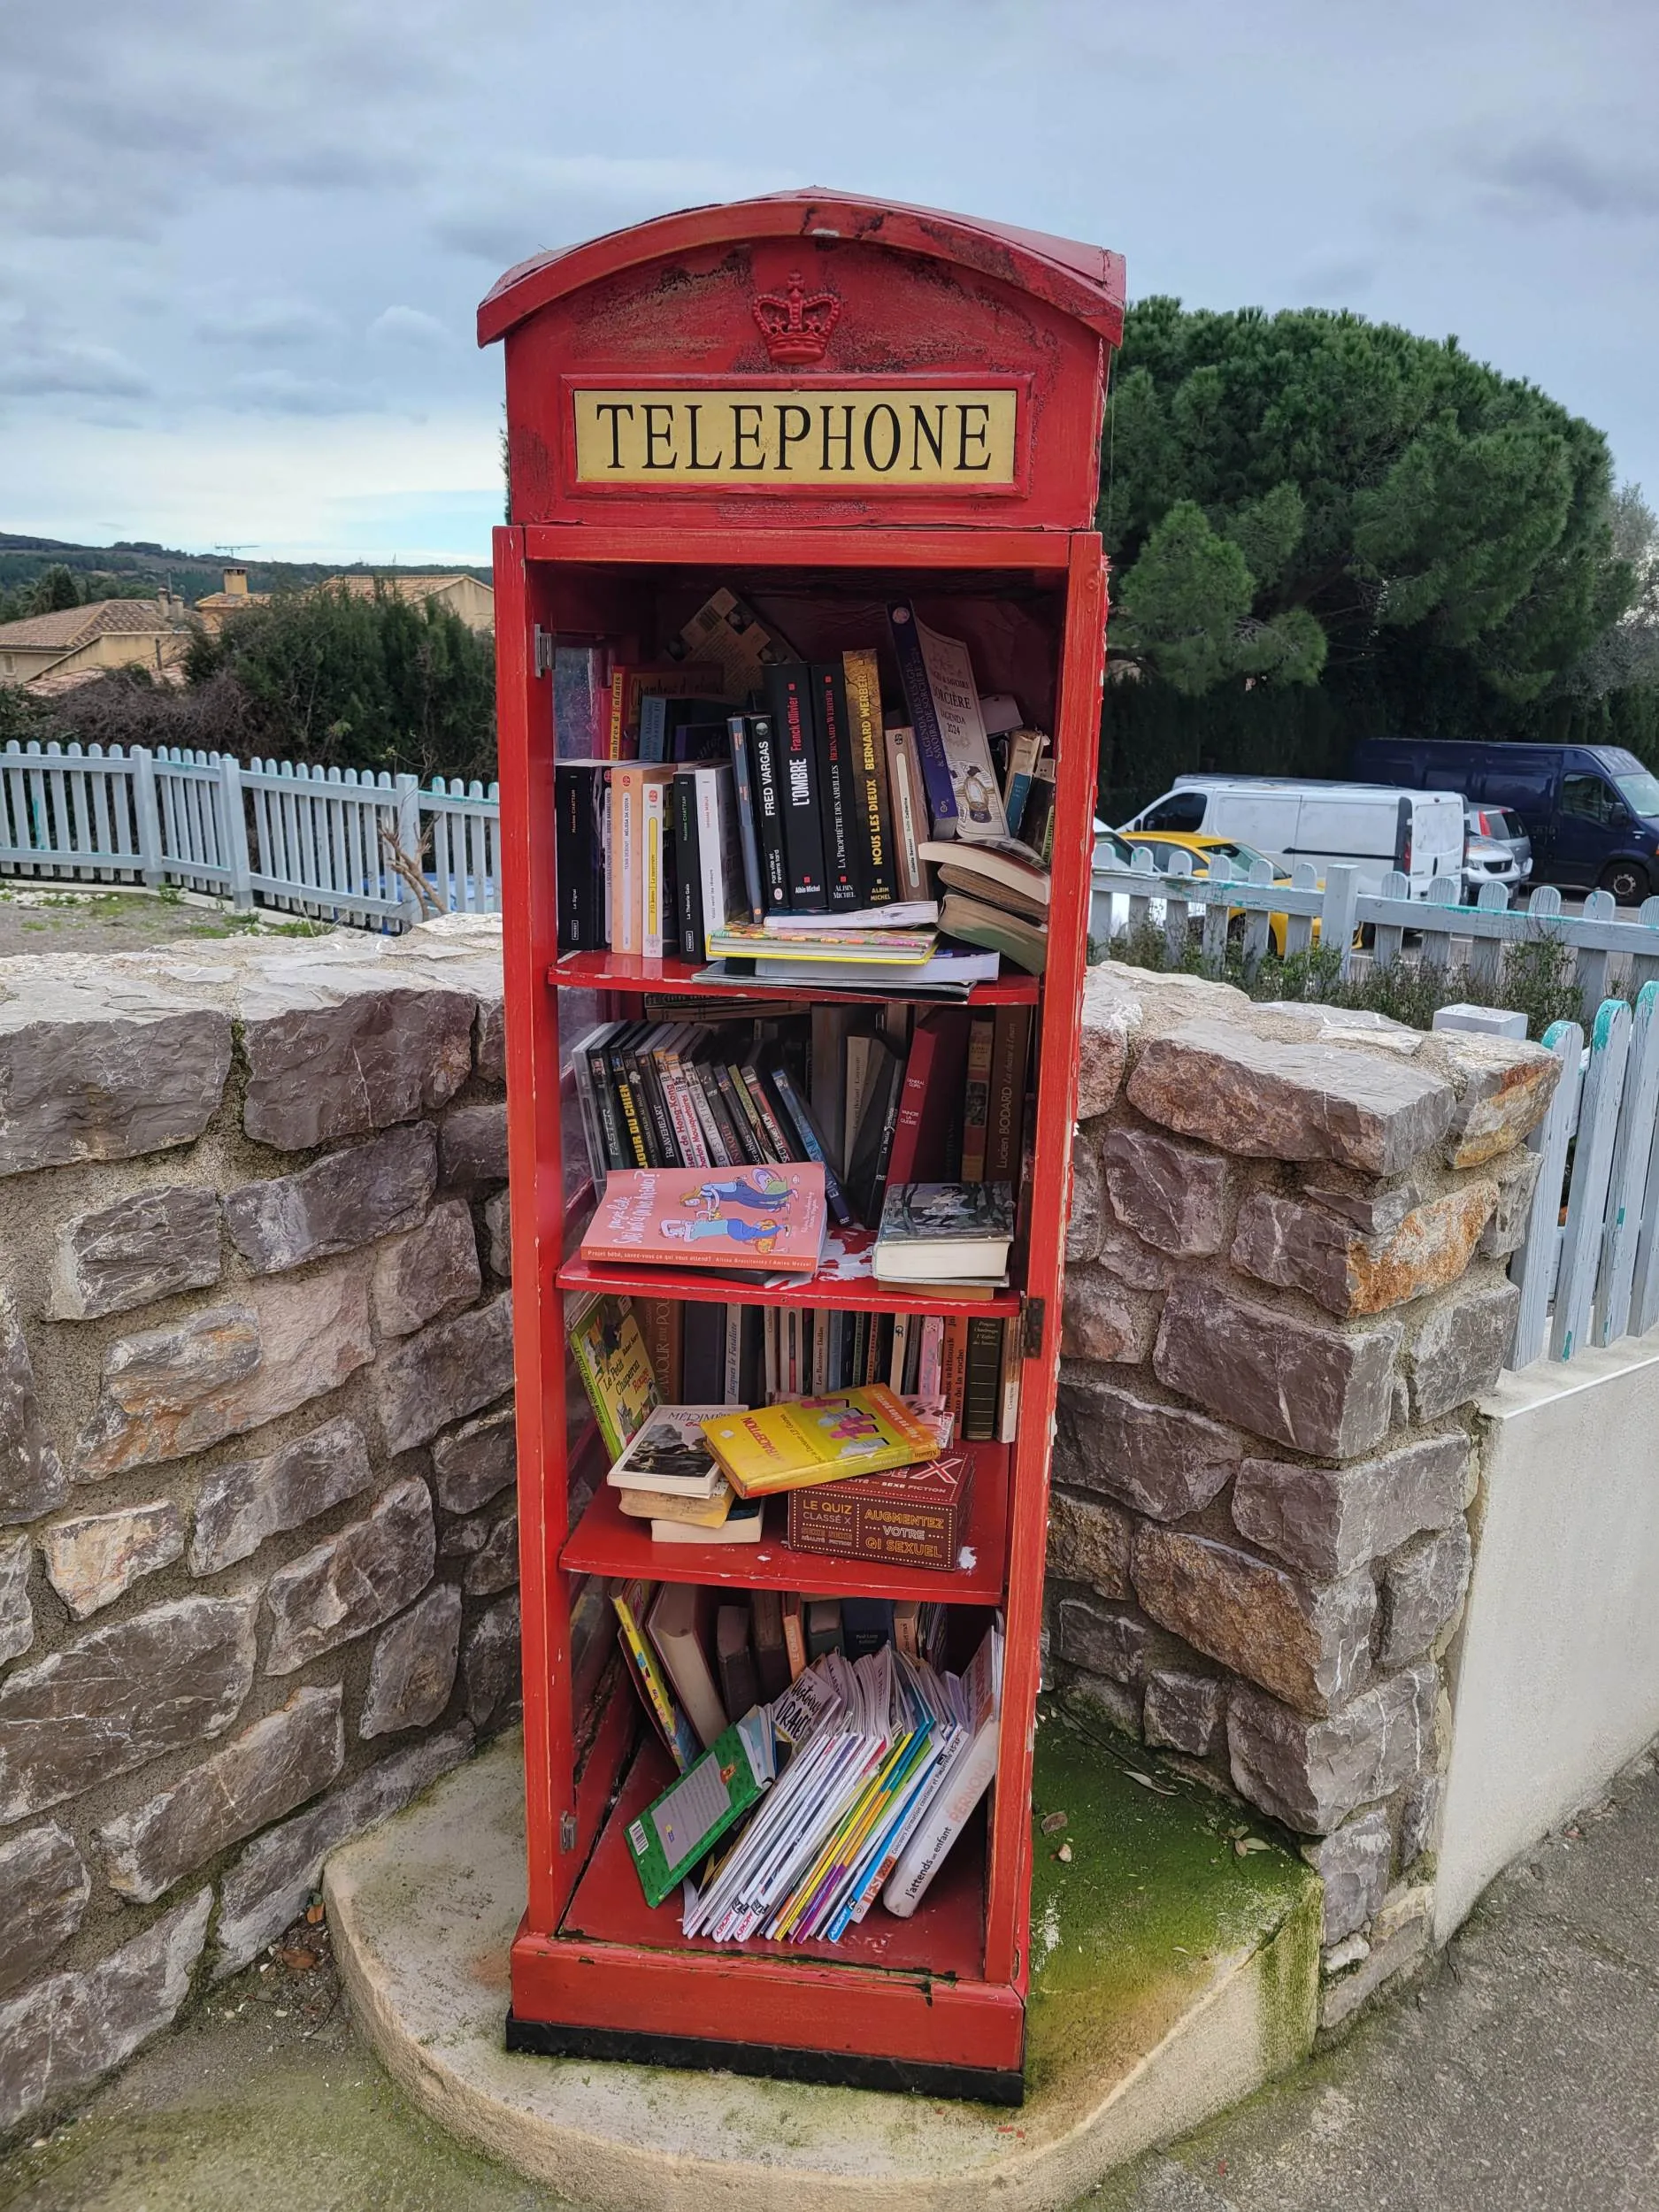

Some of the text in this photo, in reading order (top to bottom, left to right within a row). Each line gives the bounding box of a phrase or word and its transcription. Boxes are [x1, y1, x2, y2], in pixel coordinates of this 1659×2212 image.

[596, 403, 992, 471] TELEPHONE
[787, 695, 802, 752] Franck Ollivier
[857, 674, 876, 770] BERNARD WERBER
[828, 724, 839, 761] BERNARD
[758, 741, 775, 816] FRED VARGAS
[789, 758, 810, 807] L'OMBRE
[866, 780, 883, 865] NOUS LES DIEUX
[619, 1083, 648, 1169] JOUR DU CHIEN
[667, 1084, 689, 1147] de Hong-Kong
[681, 1094, 701, 1143] Mousquetaires
[762, 1112, 774, 1130] NOM
[999, 1087, 1012, 1134] BODARD
[602, 1109, 619, 1156] FASTER
[653, 1104, 674, 1159] BRAVEHEART
[775, 1141, 790, 1164] SECTE
[995, 1137, 1010, 1170] Lucien
[588, 1249, 605, 1258] Projet
[603, 1357, 625, 1392] Le Petit
[616, 1359, 641, 1396] Chaperon
[727, 1322, 741, 1398] Jacques le Fataliste
[573, 1347, 606, 1425] LE PETIT CHAPERON ROUGE
[632, 1368, 650, 1394] Rouge
[956, 1377, 963, 1389] la
[956, 1391, 963, 1403] de
[803, 1499, 853, 1515] LE QUIZ
[908, 1485, 947, 1494] FICTION
[803, 1511, 851, 1525] CLASSÉ X
[864, 1509, 945, 1529] AUGMENTEZ
[881, 1525, 926, 1540] VOTRE
[865, 1536, 942, 1559] QI SEXUEL
[775, 1697, 812, 1741] VRAIES
[951, 1759, 993, 1824] PERNOUD
[891, 1831, 908, 1855] Concours
[904, 1806, 922, 1832] formation
[918, 1784, 934, 1807] continue
[905, 1858, 934, 1899] J'attends
[934, 1826, 953, 1855] enfant
[717, 1911, 734, 1938] MICKEY
[736, 1911, 753, 1938] MICKEY
